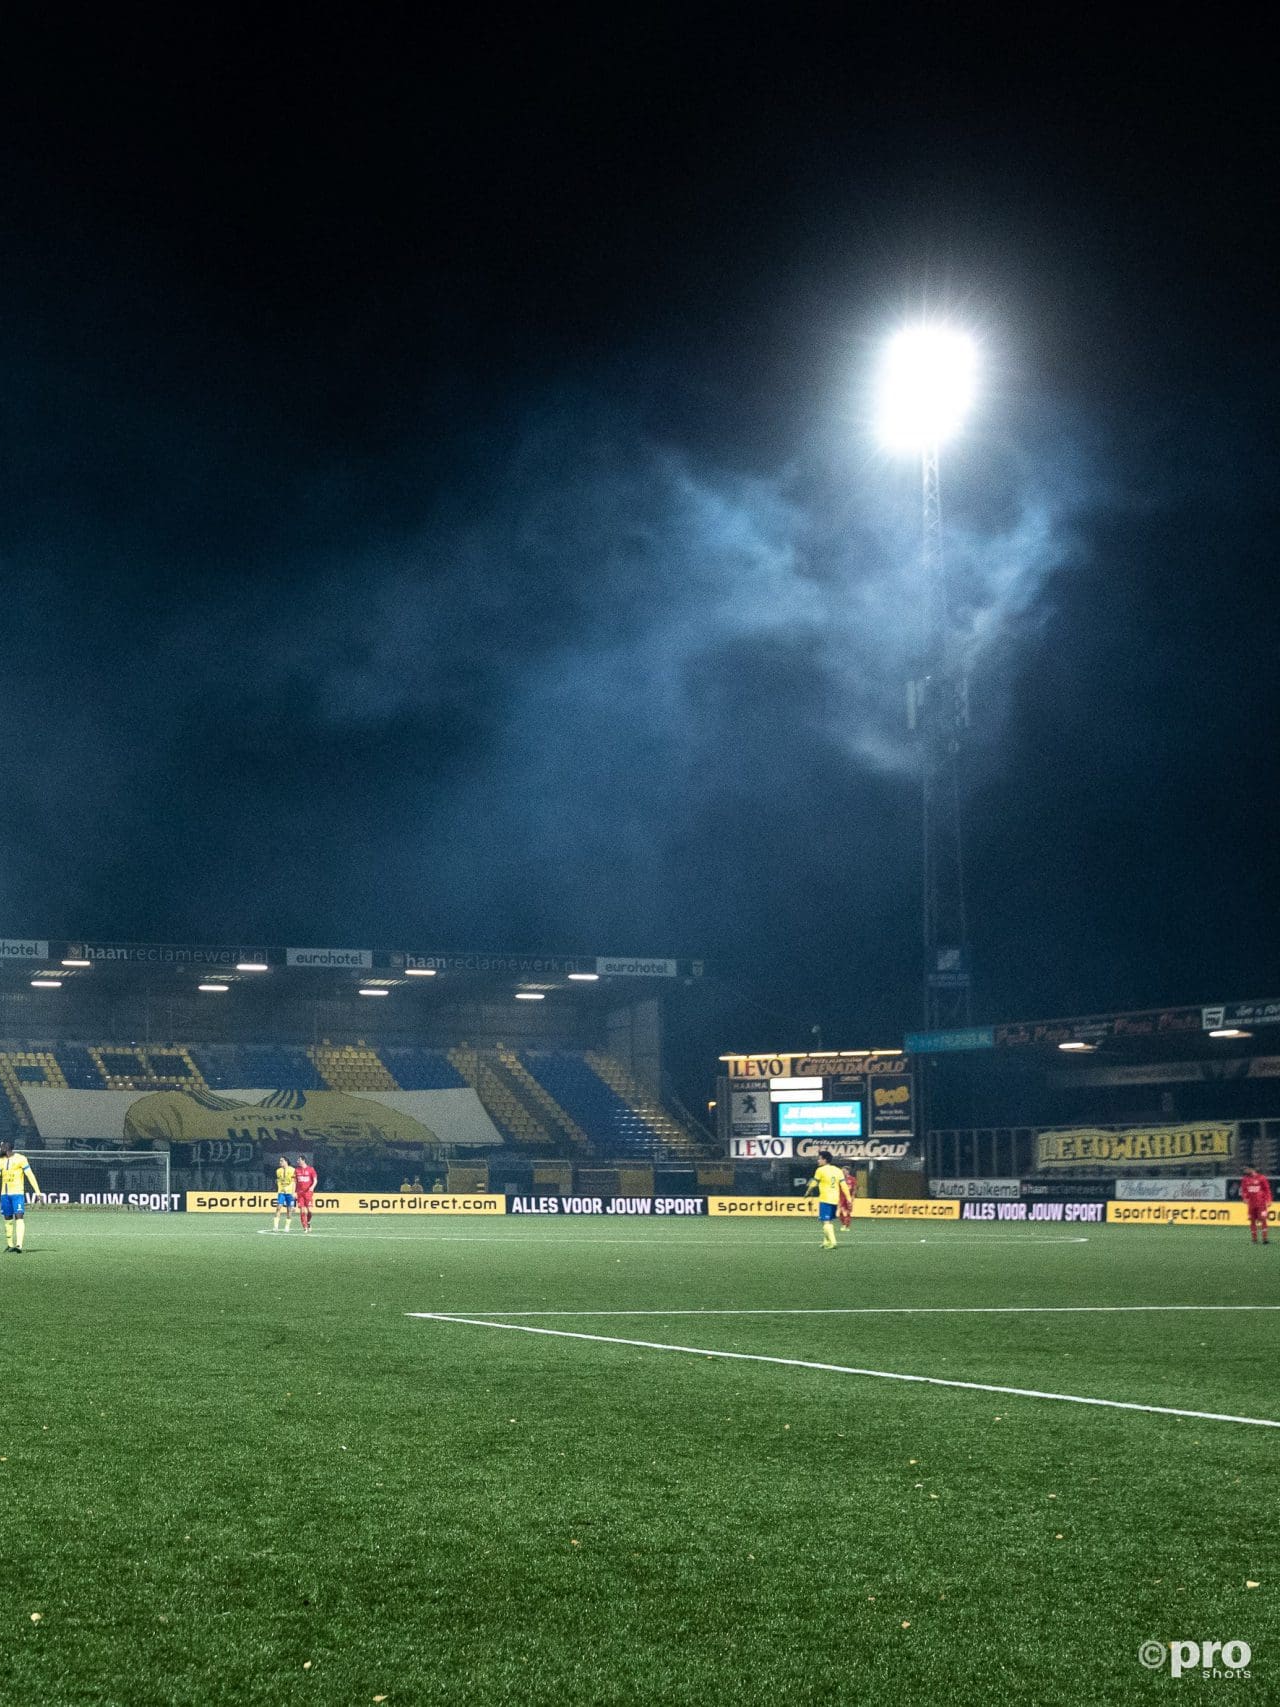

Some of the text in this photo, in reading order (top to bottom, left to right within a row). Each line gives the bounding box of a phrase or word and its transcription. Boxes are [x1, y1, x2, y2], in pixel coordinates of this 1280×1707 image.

[296, 951, 363, 965] eurohotel
[605, 960, 668, 975] eurohotel
[733, 1059, 784, 1077] LEVO
[734, 1139, 785, 1156] LEVO
[938, 1182, 1019, 1197] Auto Buikema
[128, 1194, 181, 1211] SPORT
[197, 1195, 339, 1209] sportdireom
[359, 1197, 497, 1210] sportdirect.com
[511, 1197, 704, 1215] ALLES VOOR JOUW SPORT
[718, 1200, 817, 1214] sportdirect.
[869, 1203, 953, 1216] sportdirect.com
[963, 1202, 1104, 1222] ALLES VOOR JOUW SPORT
[1114, 1206, 1230, 1223] sportdirect.com
